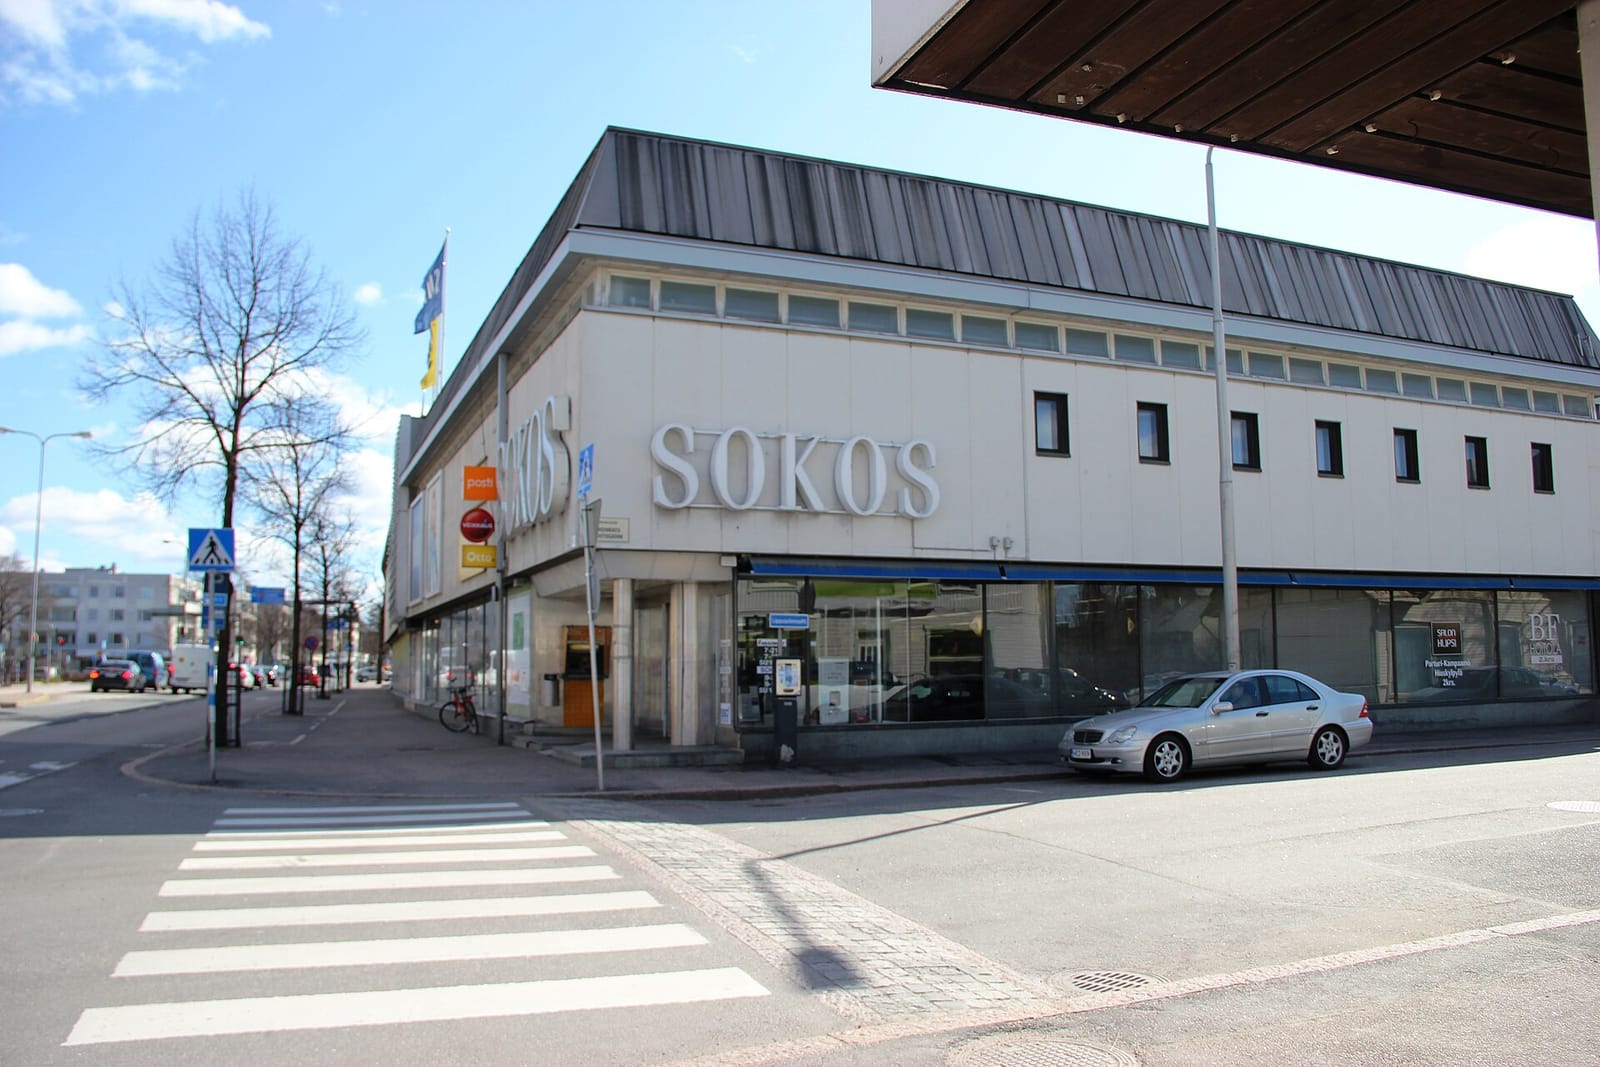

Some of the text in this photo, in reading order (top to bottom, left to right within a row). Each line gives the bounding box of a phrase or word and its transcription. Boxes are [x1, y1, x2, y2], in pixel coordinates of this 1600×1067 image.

[467, 476, 493, 489] posti
[650, 423, 940, 519] SOKOS
[1528, 613, 1561, 640] BF
